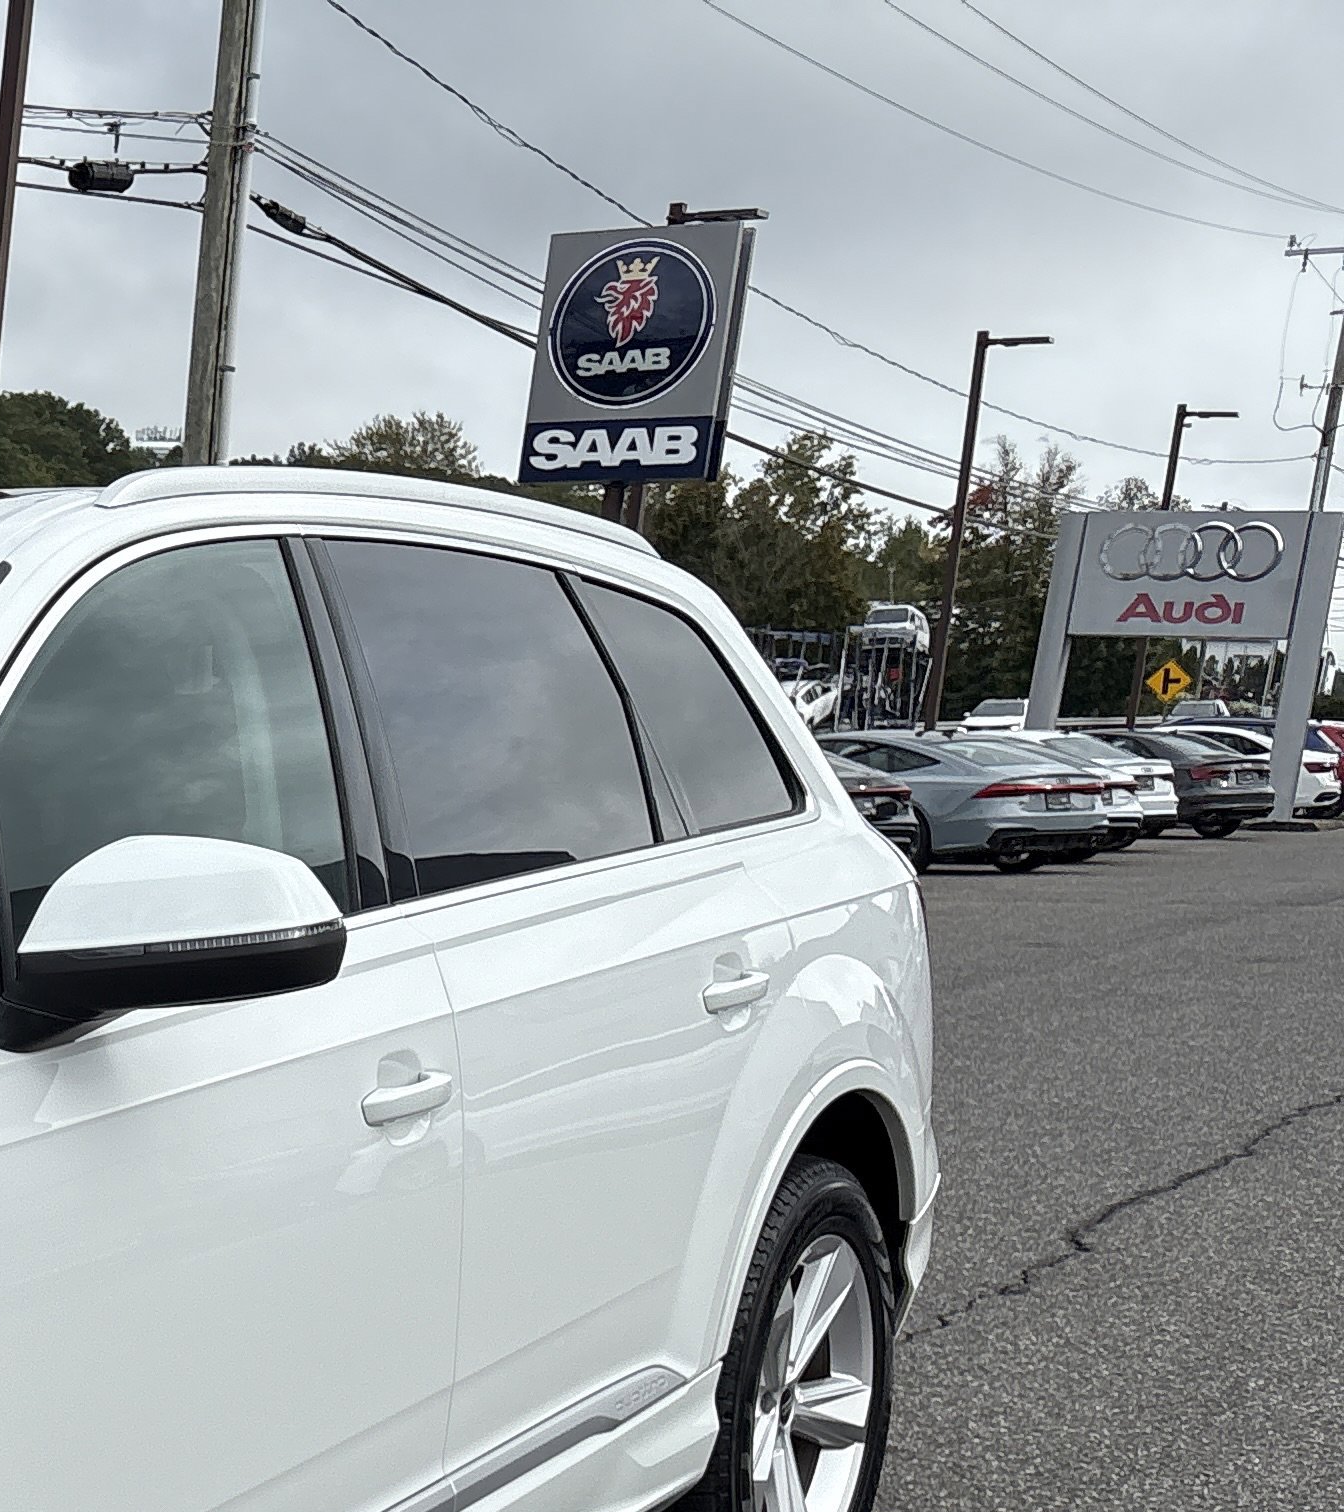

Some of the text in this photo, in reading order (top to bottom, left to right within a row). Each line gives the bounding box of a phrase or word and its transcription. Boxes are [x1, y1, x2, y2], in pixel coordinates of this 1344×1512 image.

[576, 347, 671, 377] SAAB
[529, 425, 698, 471] SAAB
[1117, 593, 1245, 624] Audi
